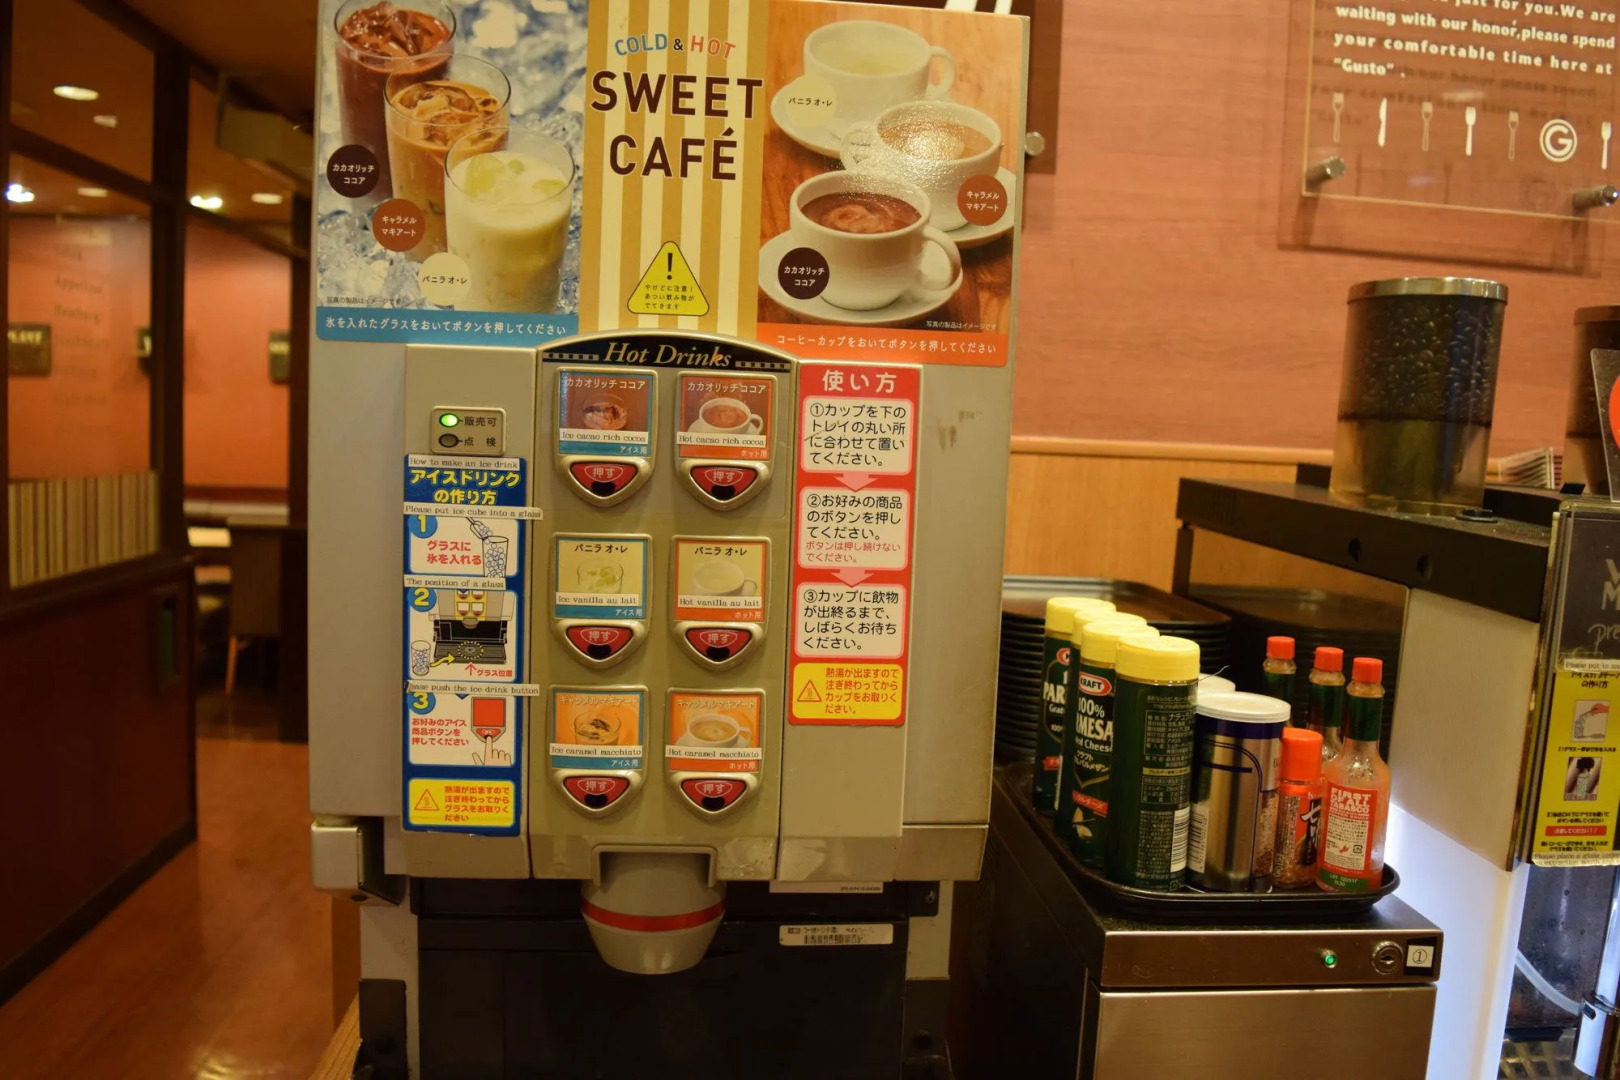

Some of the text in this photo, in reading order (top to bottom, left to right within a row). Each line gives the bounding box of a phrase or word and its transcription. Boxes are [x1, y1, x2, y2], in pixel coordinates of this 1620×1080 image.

[1590, 11, 1616, 23] are
[1336, 5, 1396, 26] waiting
[1401, 12, 1437, 28] with
[1441, 18, 1468, 31] our
[1572, 34, 1616, 49] spend
[614, 33, 736, 59] COLD & HOT
[1333, 32, 1613, 75] your comfortable time here at
[590, 70, 763, 119] SWEET
[609, 127, 738, 181] CAFÉ
[332, 163, 375, 173] カカオリッチ
[343, 176, 366, 185] ココア
[966, 190, 1000, 201] キャラメル
[966, 202, 1000, 213] マキアート
[381, 215, 418, 225] キャラメル
[381, 228, 417, 237] マキアート
[783, 265, 825, 277] カカオリッチ
[794, 278, 816, 288] ココア
[645, 302, 680, 310] でてきます
[325, 316, 567, 335] 氷を入れたグラスをおいてボタンを押してください
[777, 334, 997, 354] コーヒーカップをおいてボタンを押してください
[603, 342, 731, 367] Hot Drinks
[822, 369, 897, 394] 使い方
[810, 402, 907, 419] ①カップを下の
[464, 416, 497, 427] 販売可
[812, 419, 906, 436] トレイの丸い所
[562, 431, 646, 442] Ice cacao rich cocoa
[679, 435, 765, 446] Hot cacao rich cocoa
[809, 435, 905, 451] に合わせて置い
[619, 445, 648, 455] アイス用
[740, 449, 767, 458] ホット用
[409, 457, 427, 466] How
[441, 459, 463, 467] make
[479, 460, 492, 468] ice
[494, 461, 518, 469] drink
[810, 452, 883, 467] てください。
[410, 469, 521, 487] アイスドリンク
[592, 467, 616, 479] 押す
[712, 470, 736, 482] 押す
[433, 489, 497, 505] の作り方
[806, 493, 903, 510] ②お好みの商品
[405, 505, 432, 513] Please
[434, 507, 449, 516] put
[452, 507, 464, 515] ice
[467, 507, 487, 516] cube
[490, 509, 508, 517] into
[518, 510, 542, 519] glass
[806, 511, 902, 525] のボタンを押し
[417, 514, 427, 533] 1
[807, 526, 882, 540] てください。
[427, 540, 472, 552] グラスに
[805, 541, 901, 552] ボタンは押し続けない
[426, 553, 482, 566] 氷を入れる
[805, 552, 858, 563] でください。
[425, 579, 459, 588] position
[481, 581, 504, 589] glass
[413, 587, 430, 606] 2
[558, 595, 570, 603] Ice
[572, 595, 604, 604] vanilla
[620, 596, 637, 605] lait
[679, 597, 693, 606] Hot
[696, 598, 728, 607] vanilla
[743, 599, 760, 607] lait
[803, 589, 899, 605] ③カップに飲物
[615, 608, 643, 617] アイス用
[735, 610, 761, 619] ホット用
[803, 606, 891, 619] が出終るまで、
[804, 621, 897, 635] しばらくお待ち
[588, 630, 611, 642] 押す
[708, 632, 730, 644] 押す
[803, 637, 863, 650] ください。
[476, 669, 513, 678] グラス位置
[825, 667, 900, 678] 熱湯が出ますので
[431, 684, 451, 692] push
[485, 686, 508, 694] drink
[511, 687, 539, 695] button
[825, 680, 899, 690] 注ぎ終わってから
[825, 692, 897, 703] カップをお取りく
[1043, 681, 1065, 704] PAR
[412, 691, 429, 710] 3
[824, 703, 857, 714] ださい。
[411, 718, 467, 727] お好みのアイス
[411, 728, 461, 737] 商品ボタンを
[411, 737, 469, 746] 押してください
[1084, 739, 1112, 753] Chees
[551, 746, 641, 756] Ice caramel macchiato
[668, 748, 759, 758] Hot caramel macchiato
[611, 758, 638, 767] アイス用
[728, 761, 756, 770] ホット用
[585, 780, 608, 791] 押す
[703, 782, 726, 794] 押す
[444, 805, 509, 813] グラスをお取りく
[444, 814, 469, 822] ださい
